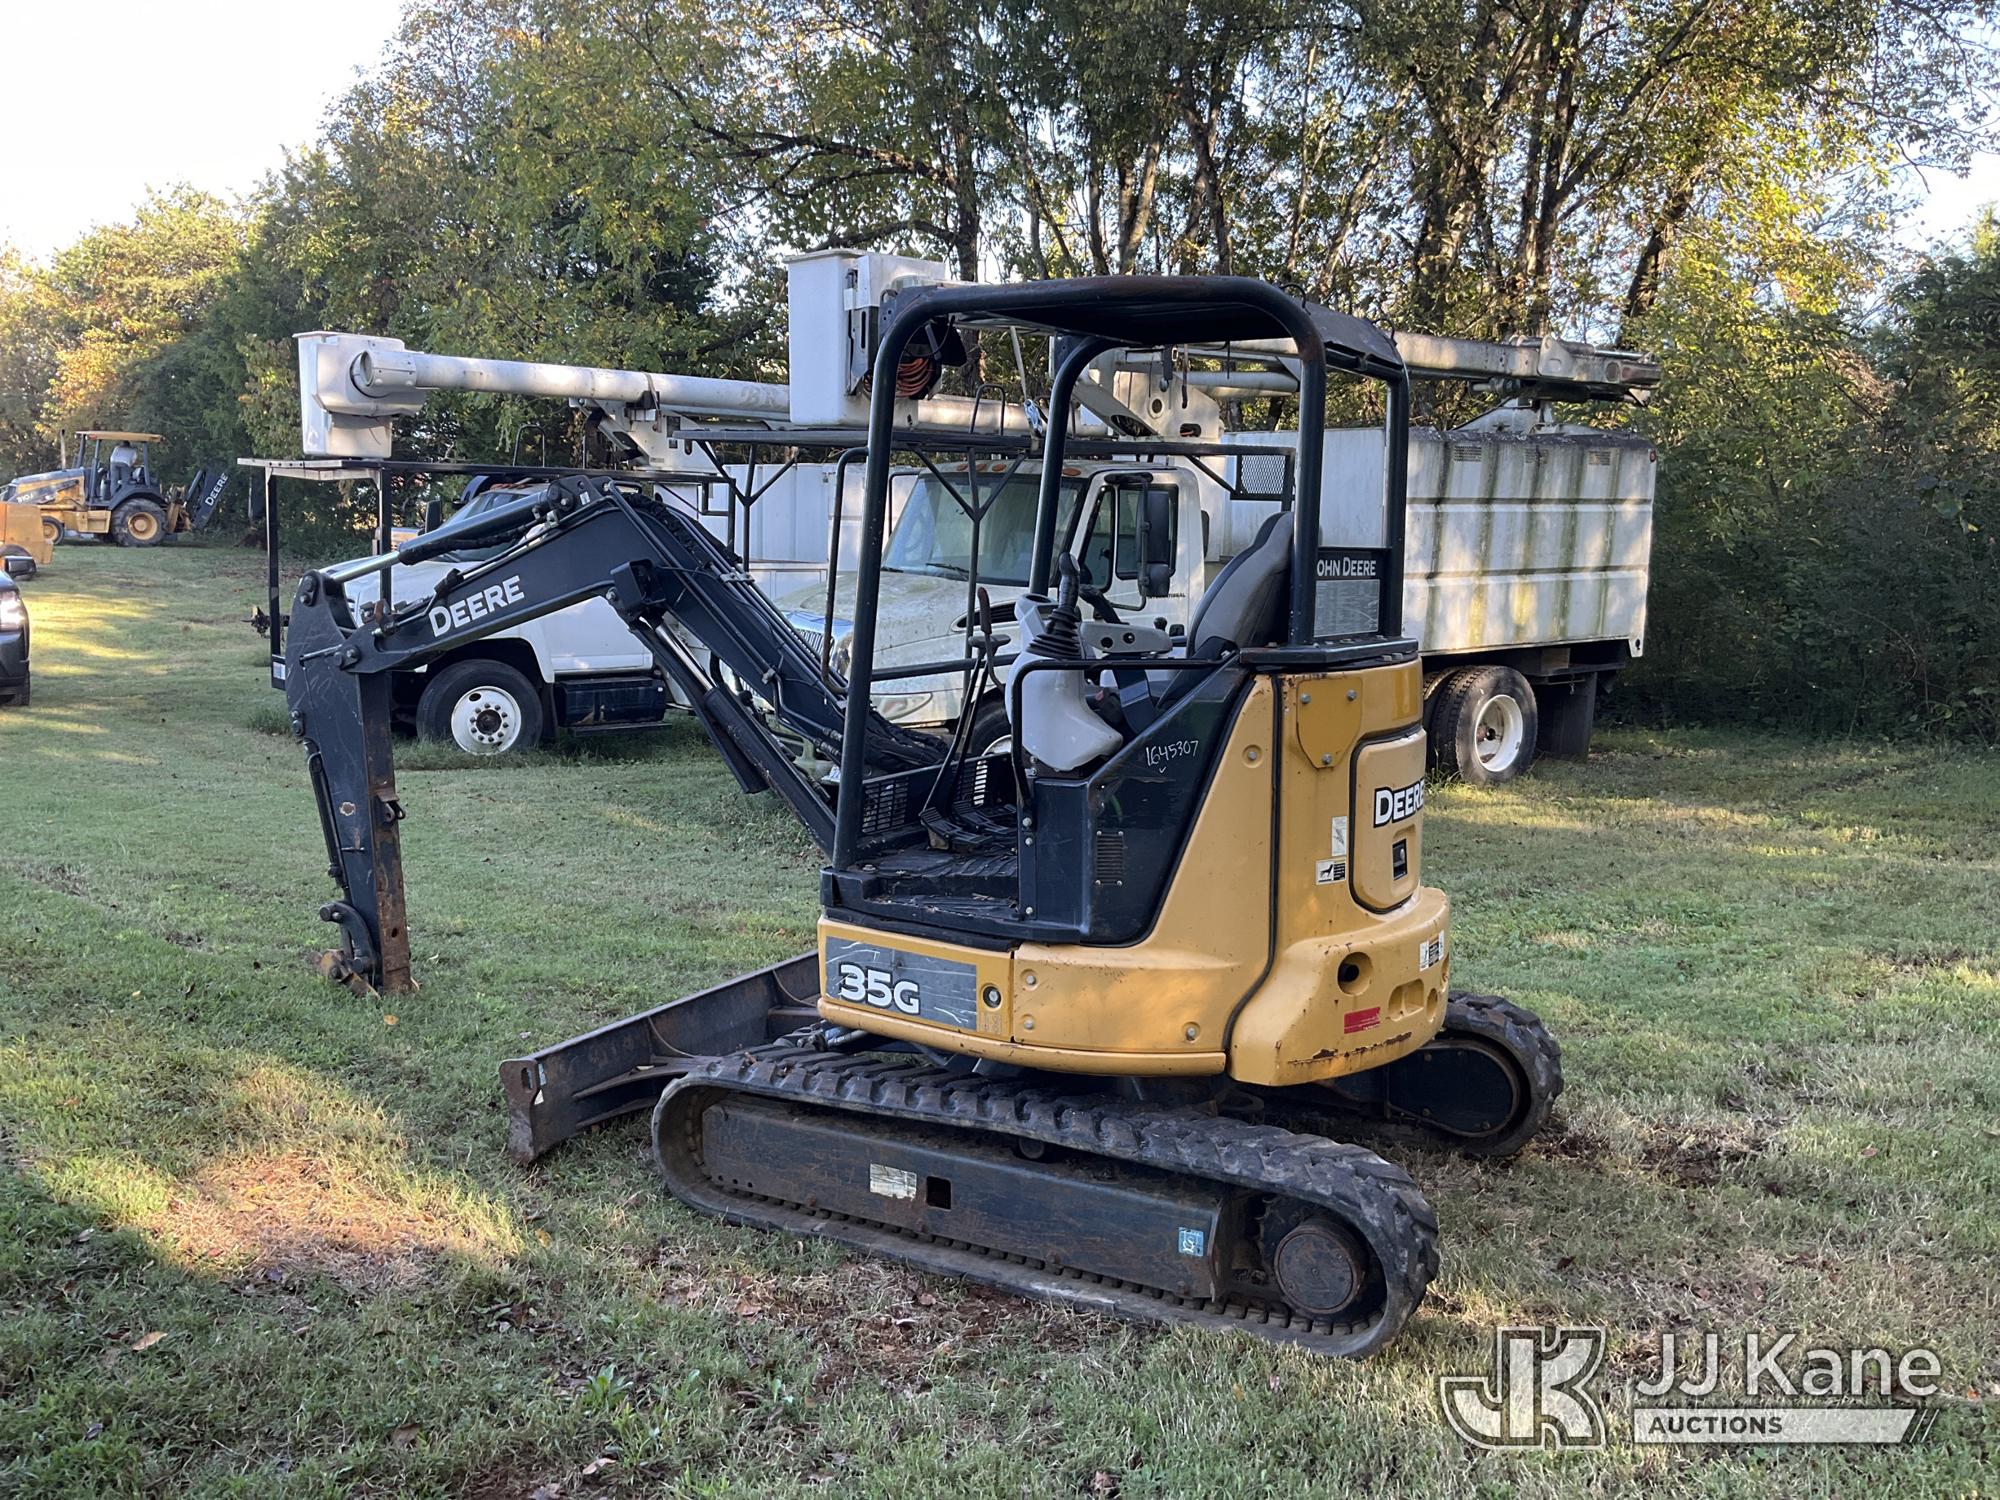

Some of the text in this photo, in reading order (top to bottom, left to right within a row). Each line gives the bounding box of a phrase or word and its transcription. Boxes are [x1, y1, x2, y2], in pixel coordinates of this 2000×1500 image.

[205, 473, 228, 506] DEERE
[1317, 557, 1376, 576] OHN DEERE
[429, 575, 525, 637] DEERE
[1146, 740, 1199, 766] 1645307
[840, 964, 920, 1014] 35G
